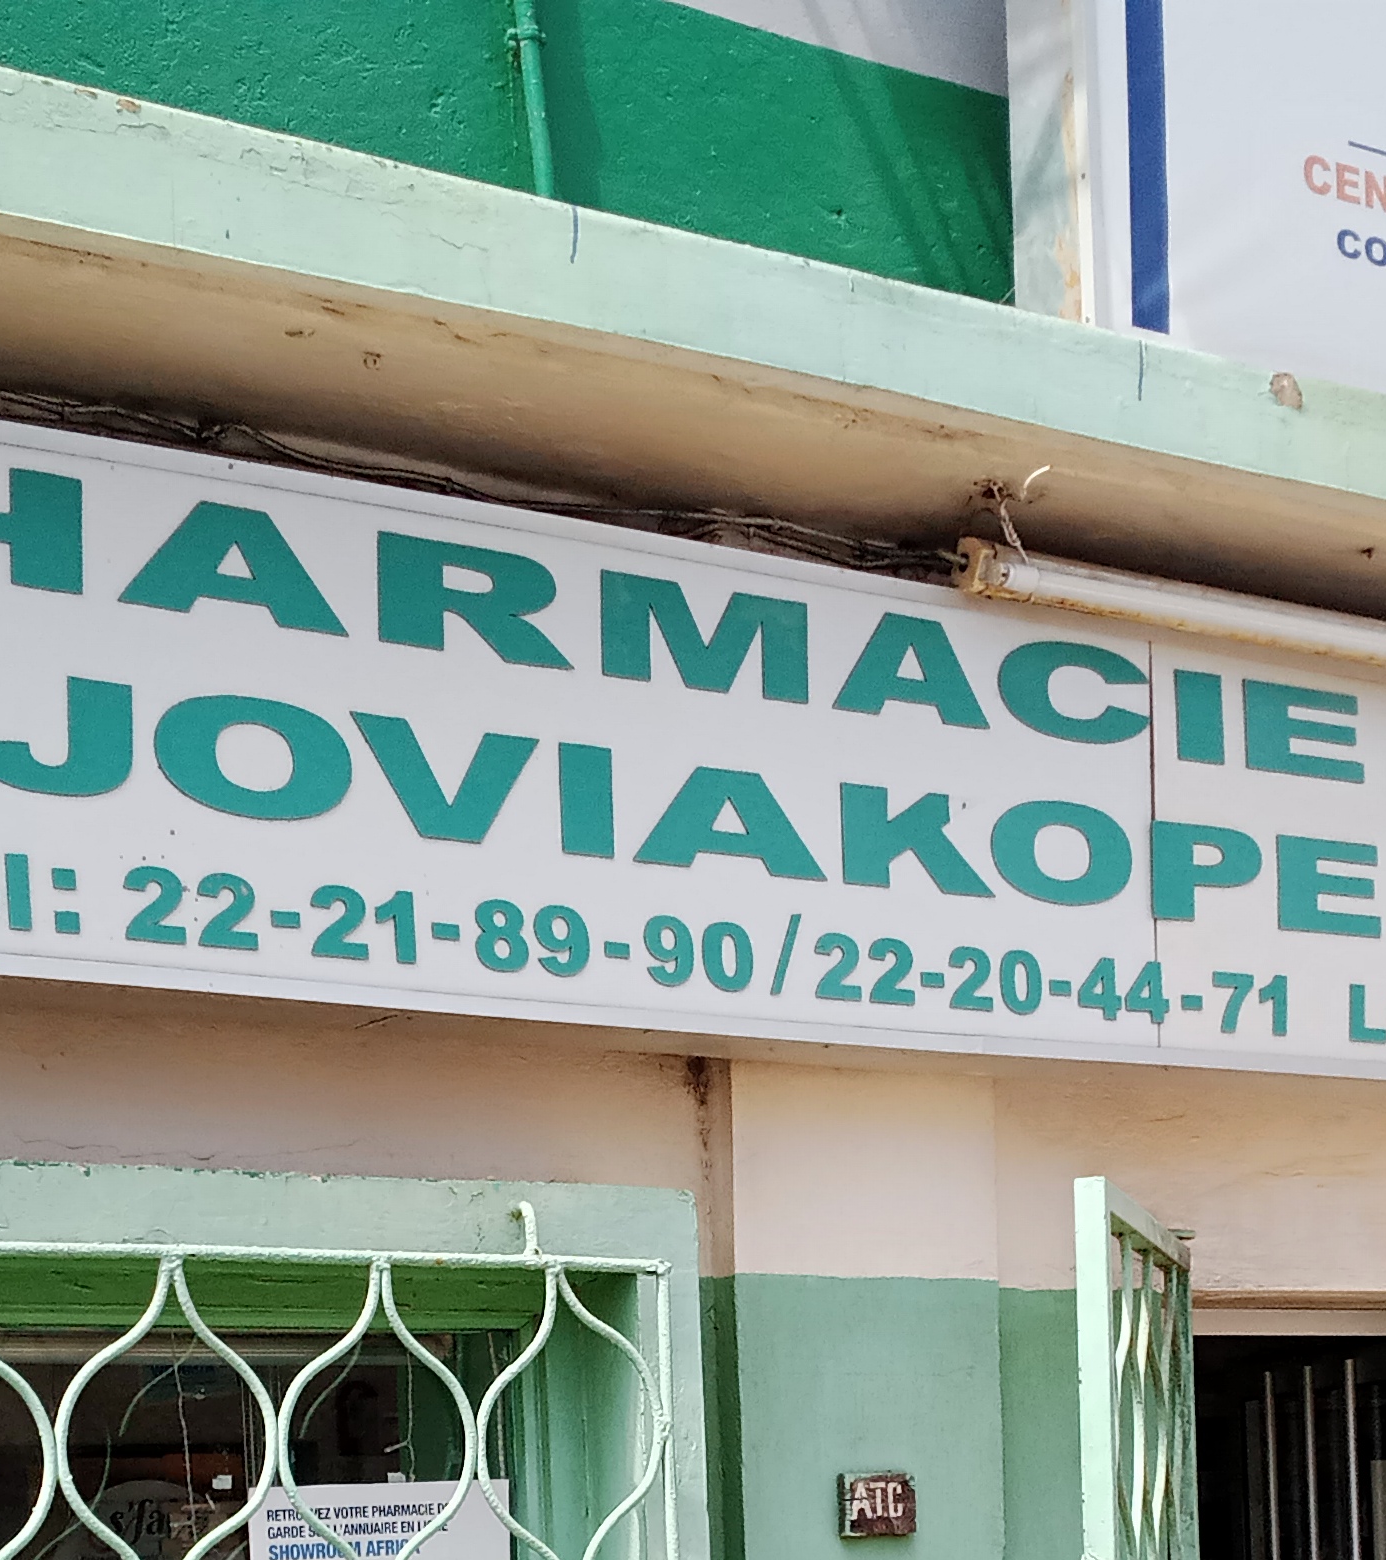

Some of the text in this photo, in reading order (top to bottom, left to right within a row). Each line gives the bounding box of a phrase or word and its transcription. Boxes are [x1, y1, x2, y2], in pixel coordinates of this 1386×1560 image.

[849, 1481, 904, 1521] ATC
[266, 1502, 450, 1523] RETROVEZ VOTRE PHARMACIE D
[267, 1525, 306, 1540] GARDE
[333, 1521, 398, 1537] L'ANNUAIRE
[400, 1520, 414, 1533] EN
